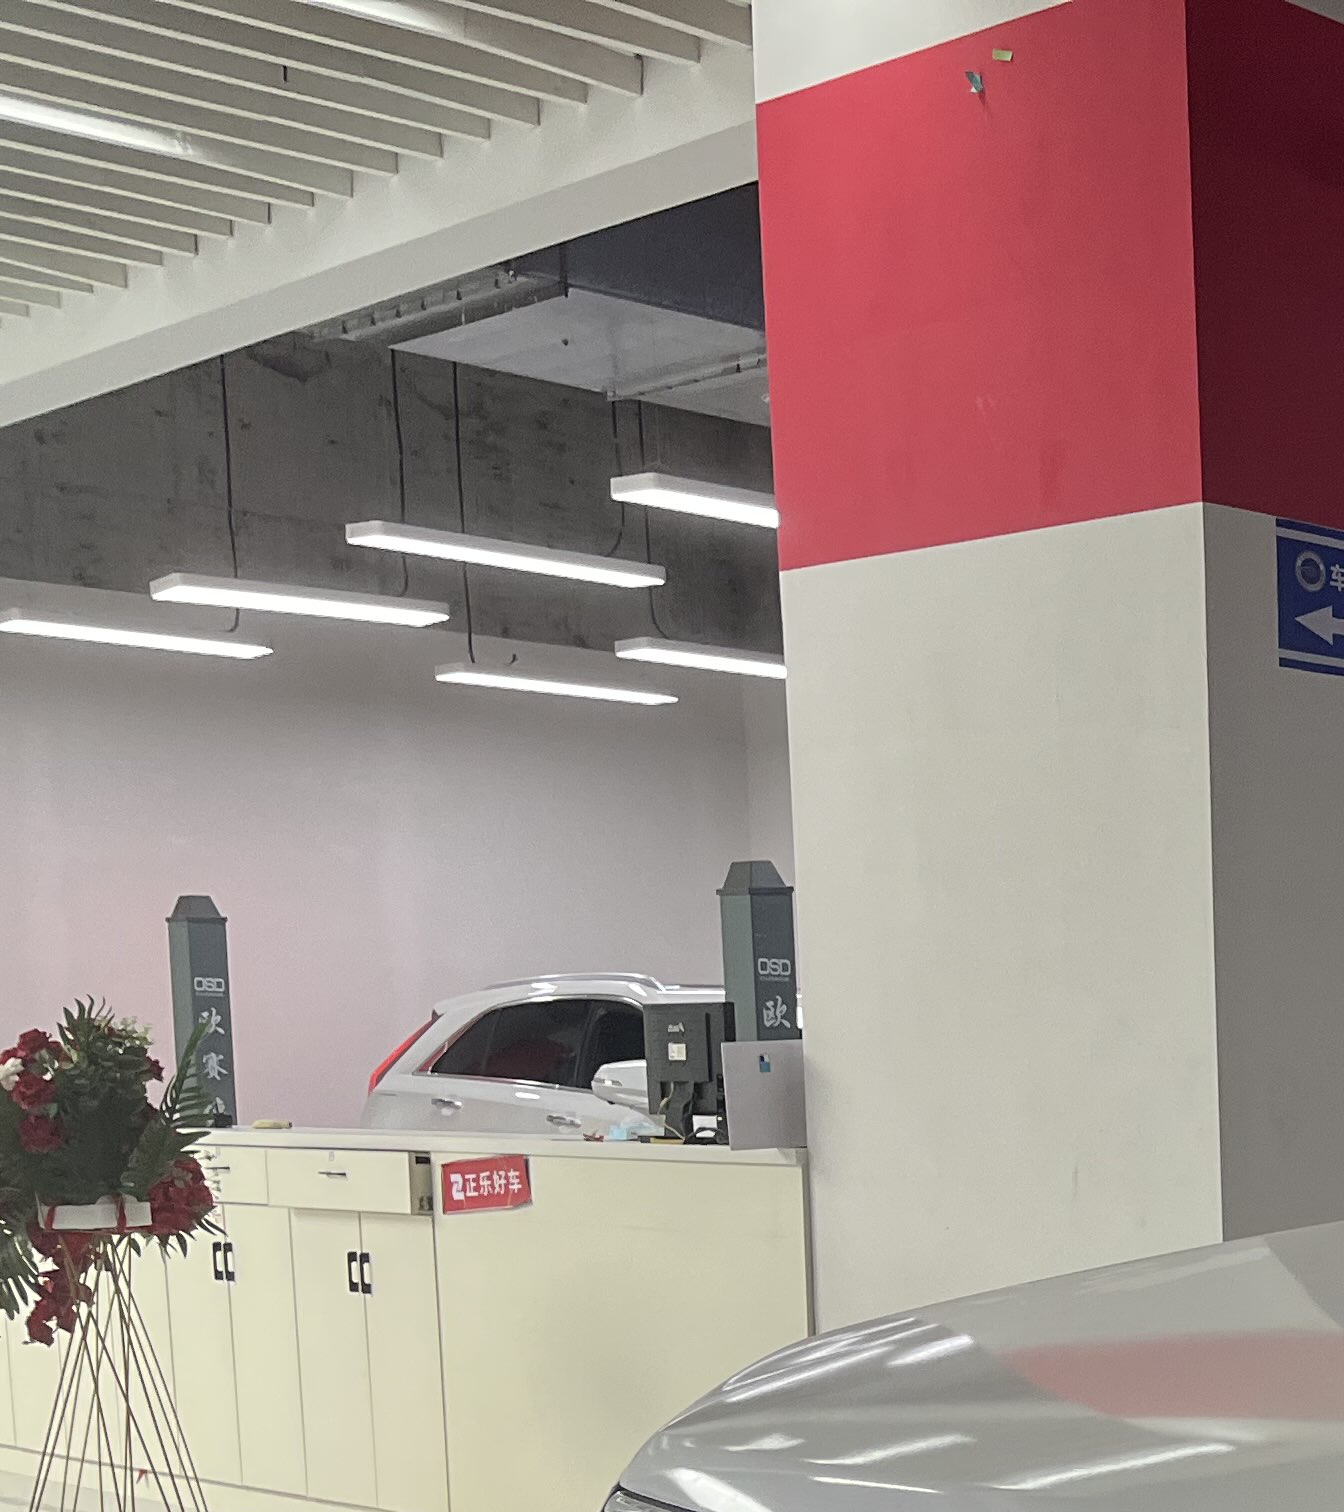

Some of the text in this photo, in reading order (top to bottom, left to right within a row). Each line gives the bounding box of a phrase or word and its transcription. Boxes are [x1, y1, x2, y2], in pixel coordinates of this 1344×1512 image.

[757, 957, 792, 976] OSD
[193, 976, 226, 993] OSD
[463, 1167, 523, 1198] 正乐好车
